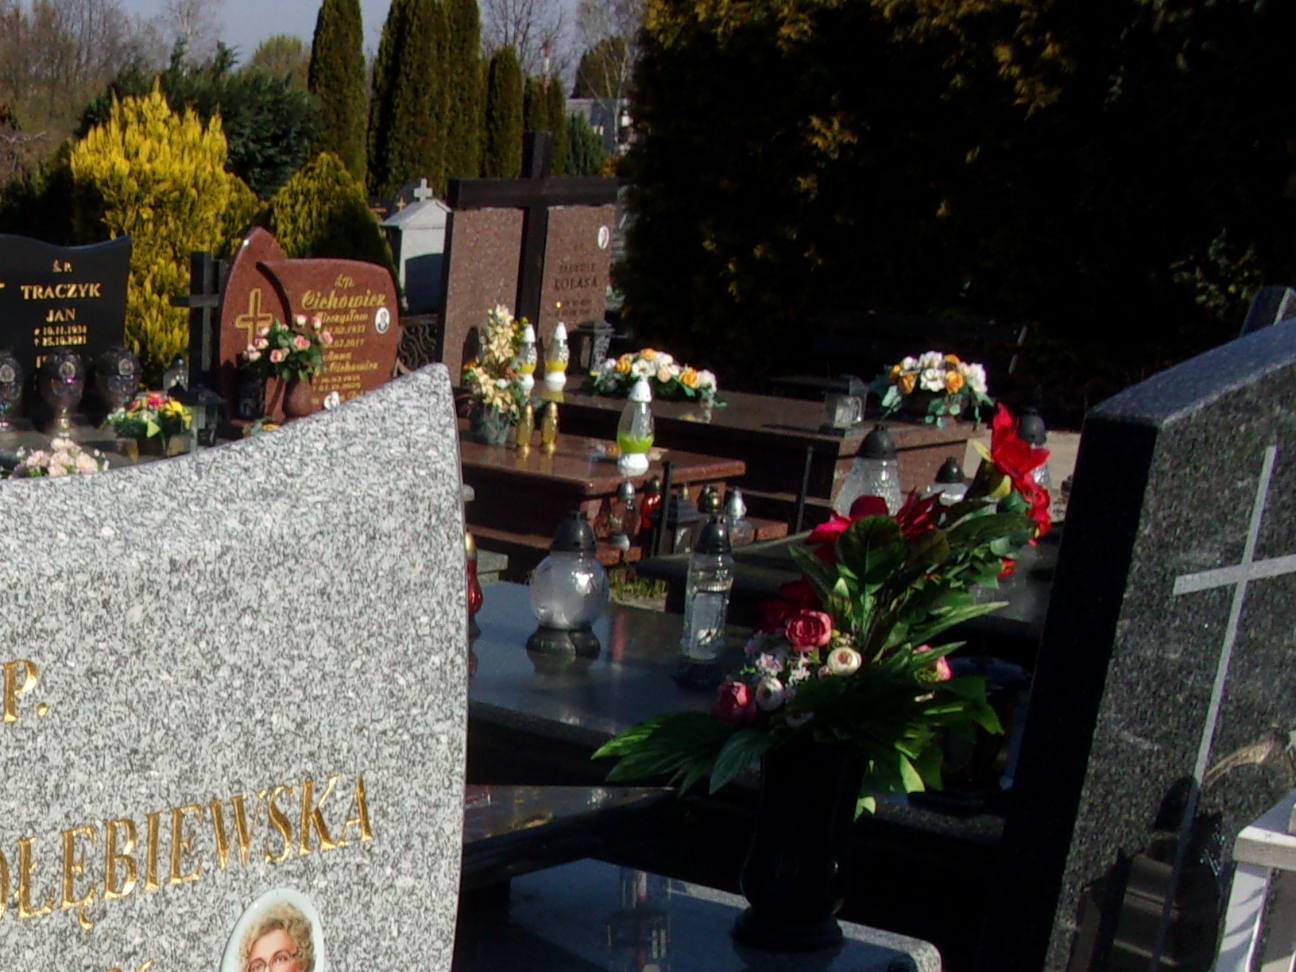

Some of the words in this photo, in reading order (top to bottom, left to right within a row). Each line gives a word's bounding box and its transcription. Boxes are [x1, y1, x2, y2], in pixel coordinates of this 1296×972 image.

[21, 283, 101, 299] TRACZYK
[301, 289, 386, 311] Cichowicz
[45, 307, 76, 323] JAN
[1, 659, 50, 723] P.
